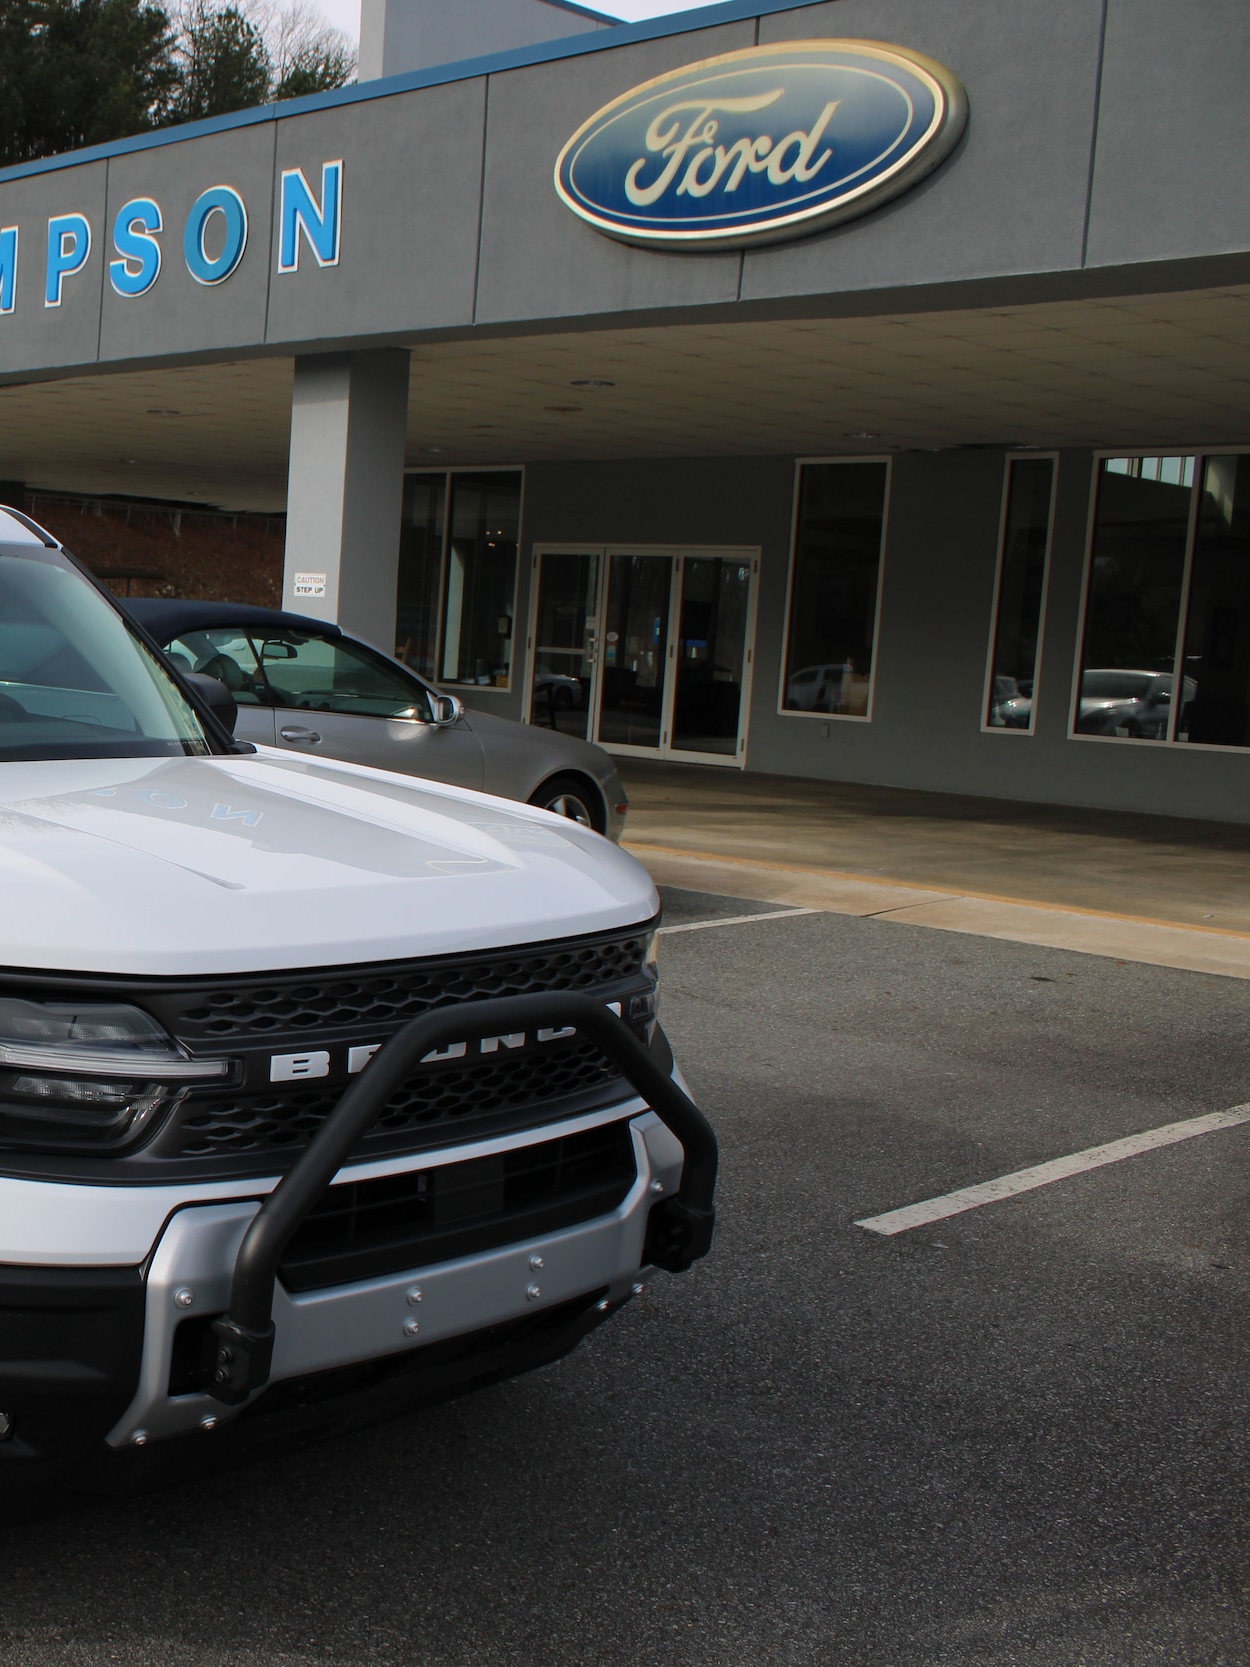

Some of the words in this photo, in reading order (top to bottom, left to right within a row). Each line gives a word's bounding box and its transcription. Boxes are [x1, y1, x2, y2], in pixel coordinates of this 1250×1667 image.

[625, 88, 841, 206] Ford
[296, 576, 325, 584] CAUTION
[296, 586, 313, 594] STEP
